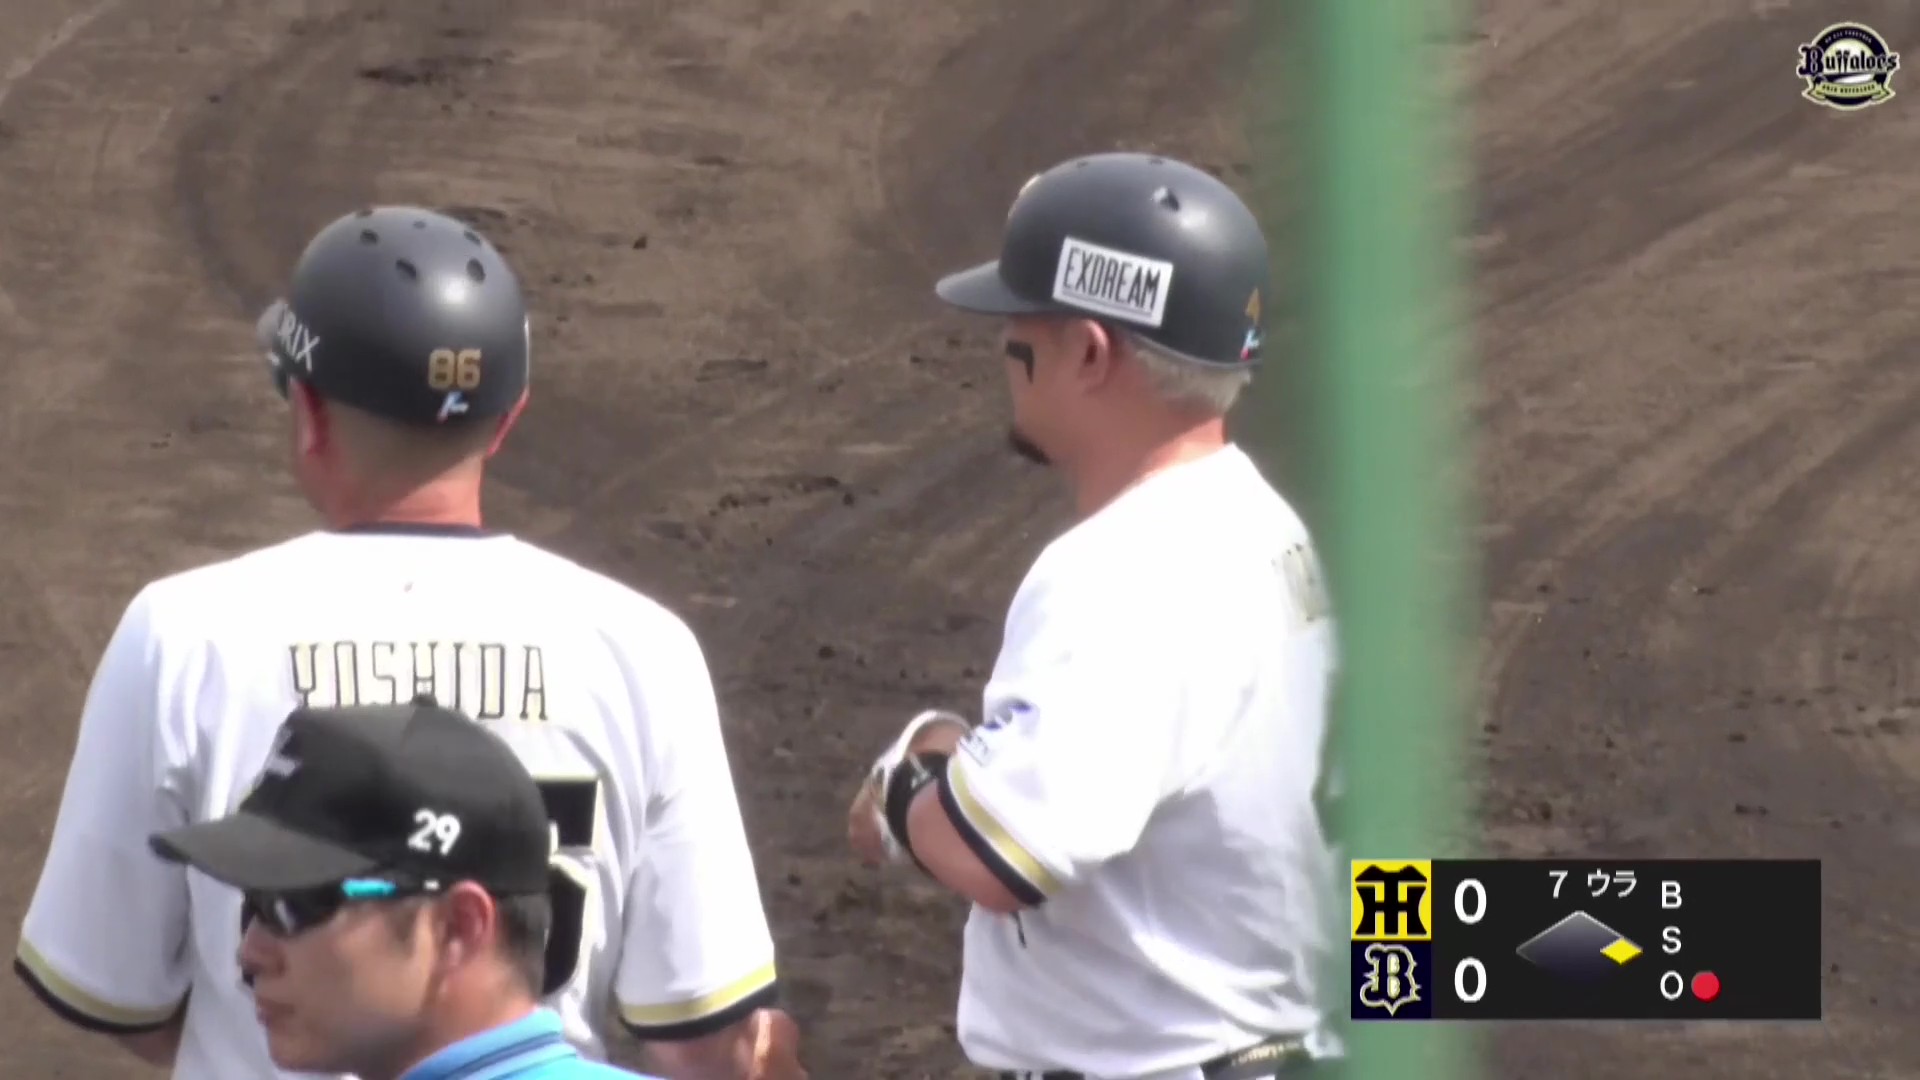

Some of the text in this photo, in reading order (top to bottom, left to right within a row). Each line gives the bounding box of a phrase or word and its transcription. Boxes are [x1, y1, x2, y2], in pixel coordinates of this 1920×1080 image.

[1062, 247, 1162, 312] EXDREAM
[277, 301, 321, 373] RIX
[428, 347, 482, 390] 86
[288, 640, 548, 721] YOSHIDA
[407, 808, 462, 856] 29
